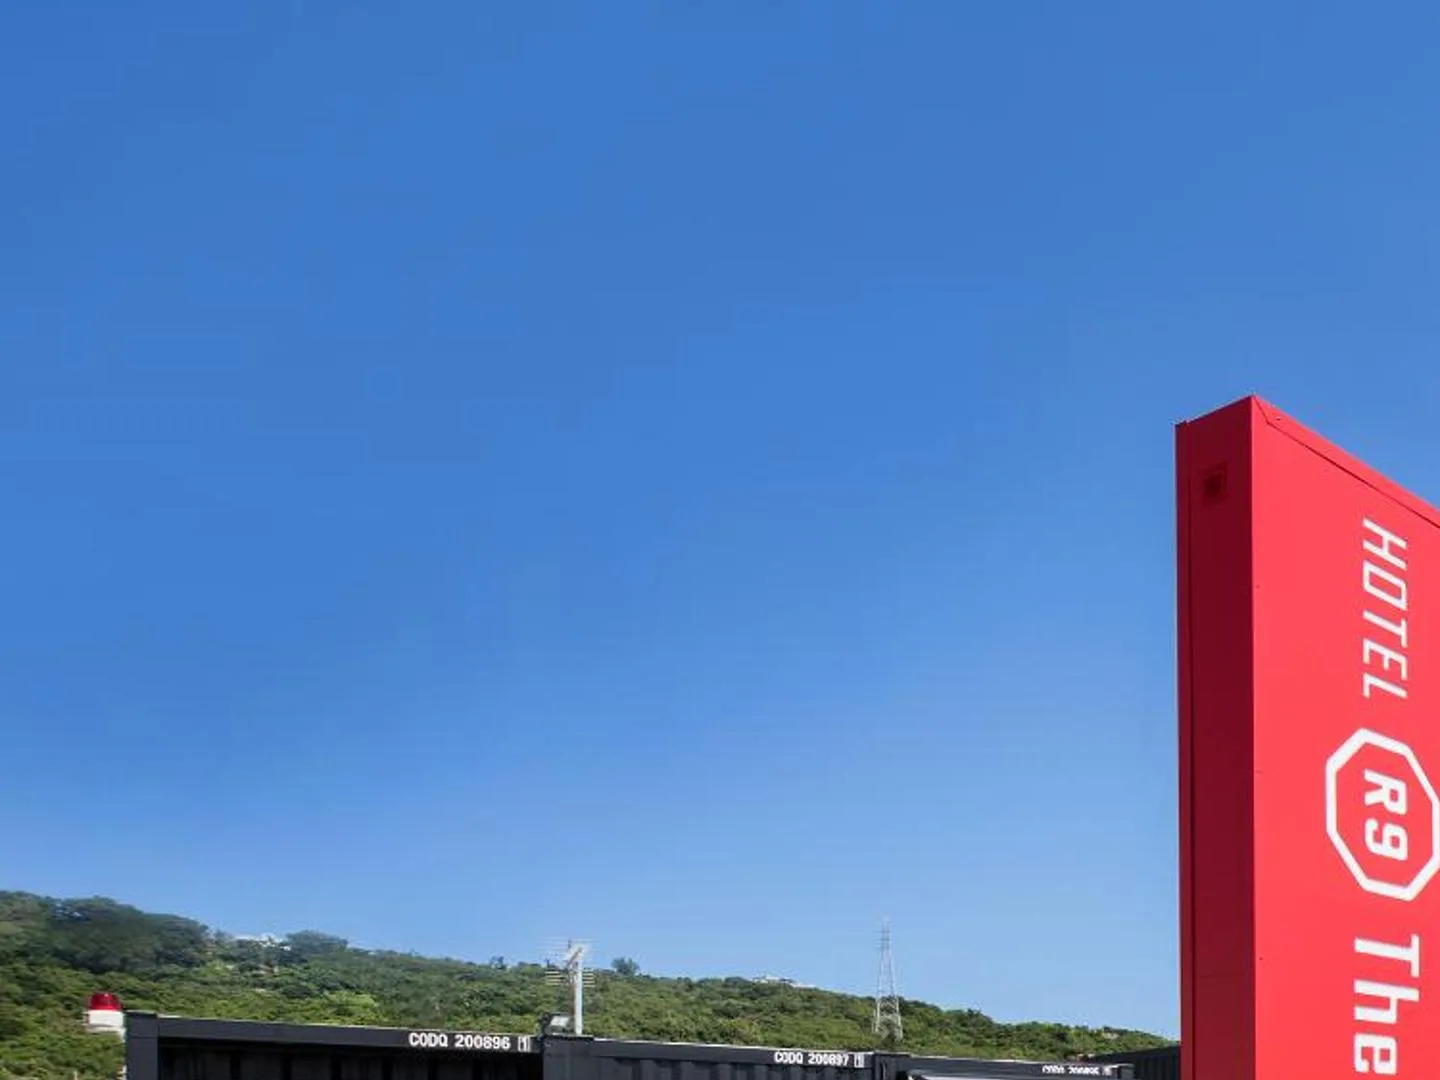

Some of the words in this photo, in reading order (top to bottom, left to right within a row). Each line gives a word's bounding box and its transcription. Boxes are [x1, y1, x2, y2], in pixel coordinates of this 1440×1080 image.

[1353, 517, 1408, 699] HOTEL
[1364, 768, 1408, 862] R9
[1354, 933, 1420, 1076] The
